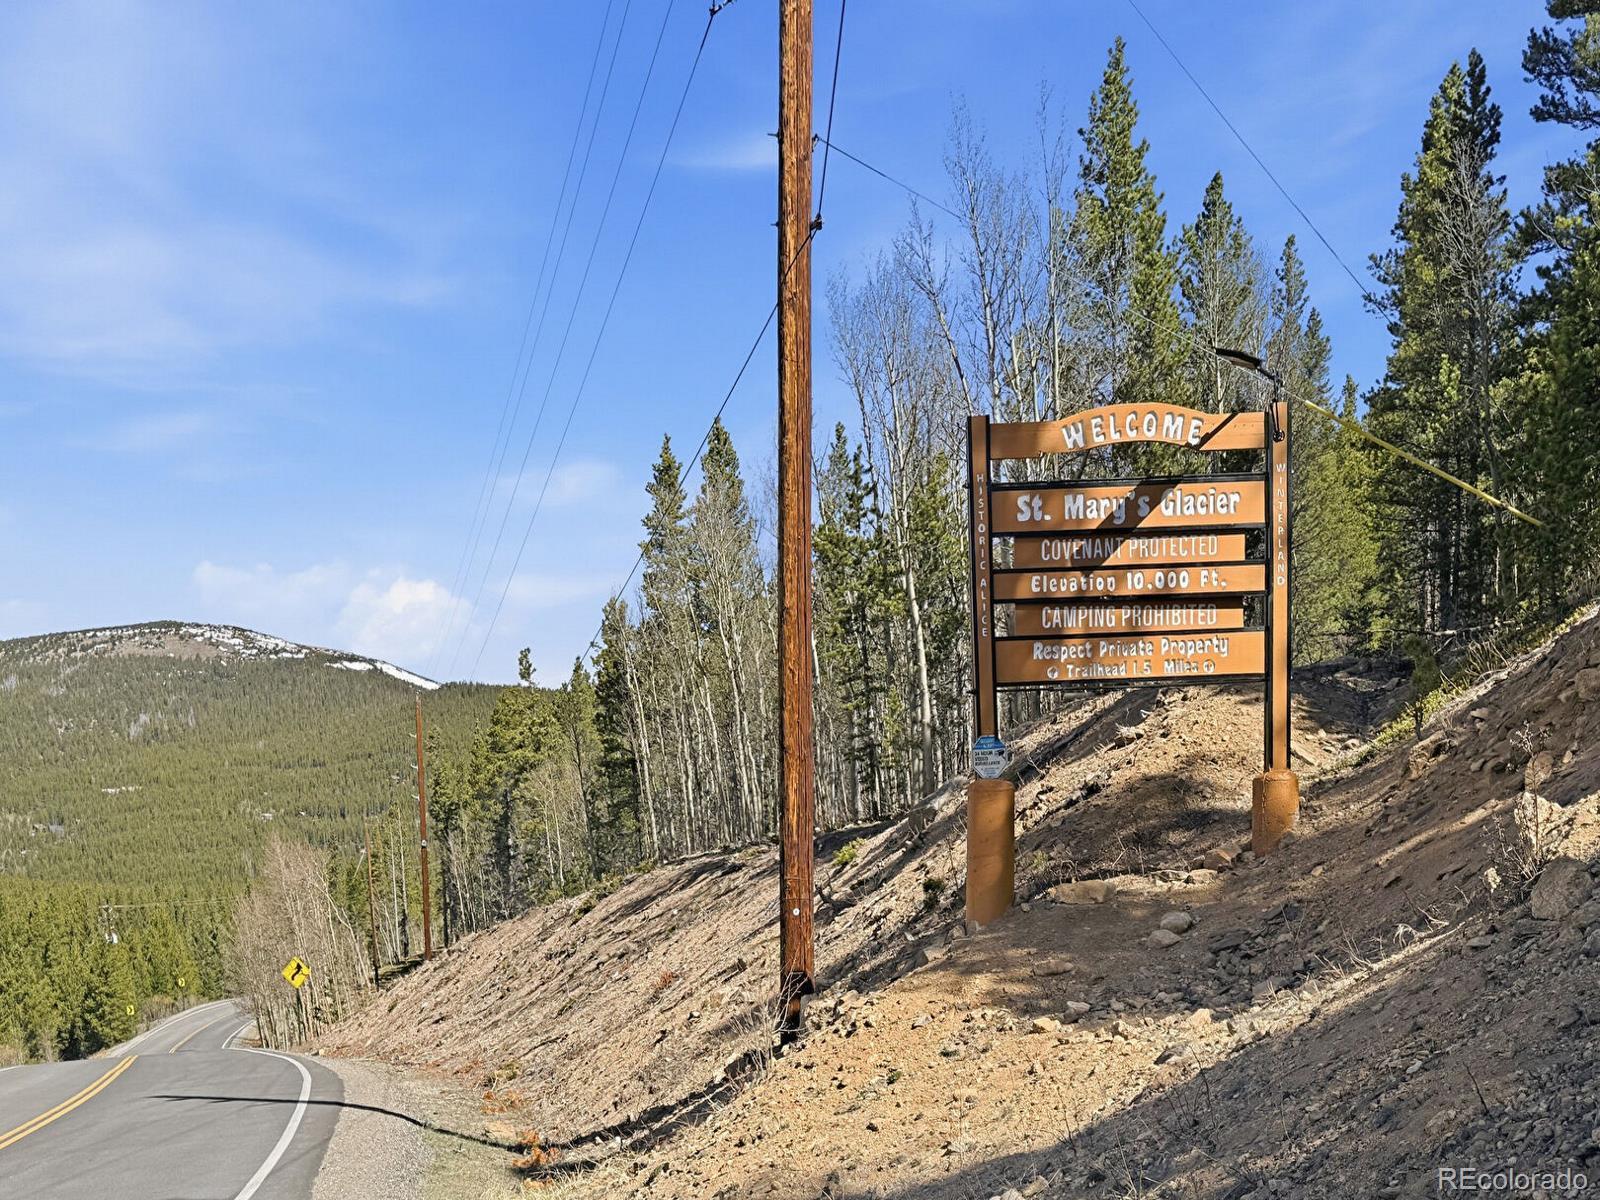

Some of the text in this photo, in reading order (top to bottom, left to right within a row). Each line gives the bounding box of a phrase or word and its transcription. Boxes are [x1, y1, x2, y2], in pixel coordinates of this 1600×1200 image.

[1062, 411, 1204, 449] WELCOME
[1016, 488, 1241, 524] St. Mary's Glacier
[1276, 463, 1286, 586] WINTERLAND
[977, 474, 988, 637] HISTORIC ALICE
[1041, 535, 1218, 561] COVENANT PROTECTED
[1031, 572, 1116, 593] Elevation
[1200, 569, 1228, 588] Ft.
[1041, 603, 1217, 629] CAMPING PROHIBITED
[1033, 635, 1229, 662] Respect Private Property
[1066, 661, 1127, 678] Trailhead
[1164, 659, 1199, 674] Miles
